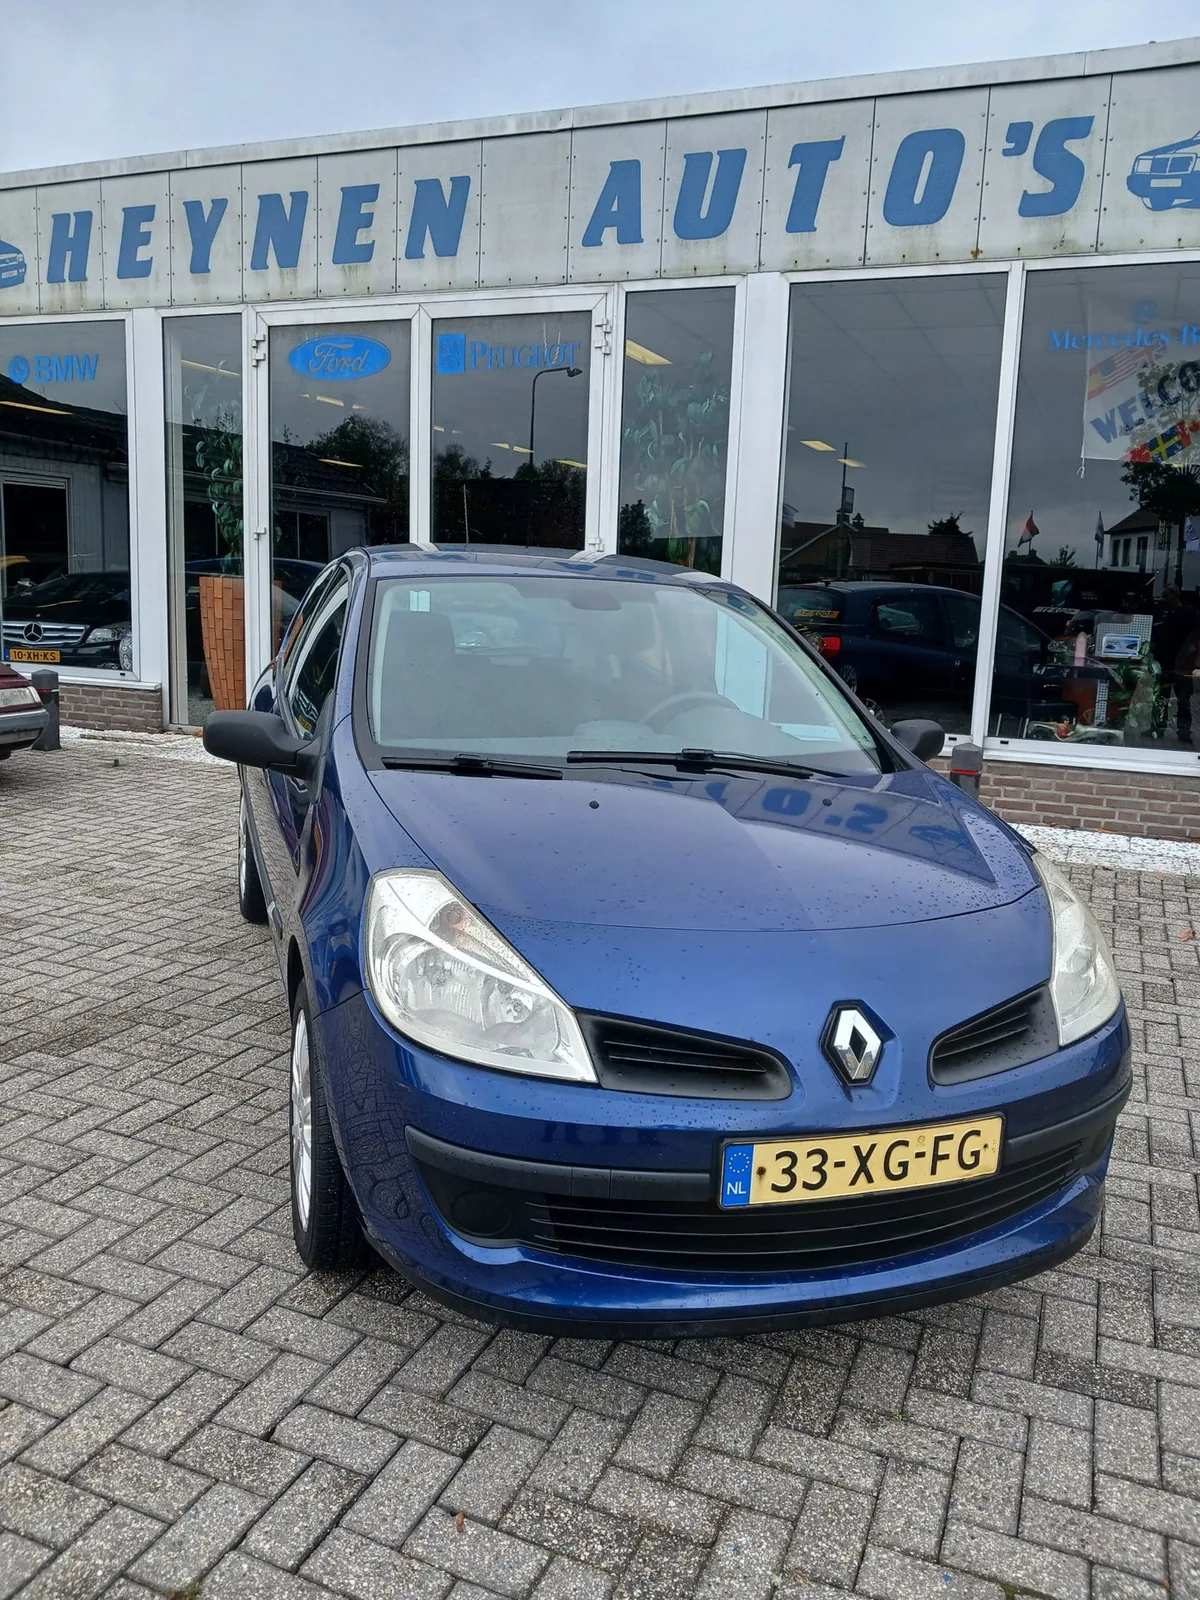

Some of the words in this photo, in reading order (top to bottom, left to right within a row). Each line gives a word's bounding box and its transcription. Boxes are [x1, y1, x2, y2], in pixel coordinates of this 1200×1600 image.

[46, 175, 471, 284] HEYNEN
[581, 115, 1095, 247] AUTO'S
[35, 353, 99, 383] BMW
[308, 342, 370, 373] Ford
[470, 340, 583, 370] PEUGEOT
[13, 650, 56, 661] 10-XH-KS
[726, 1181, 747, 1195] NL
[770, 1129, 982, 1193] 33-XG-FG
